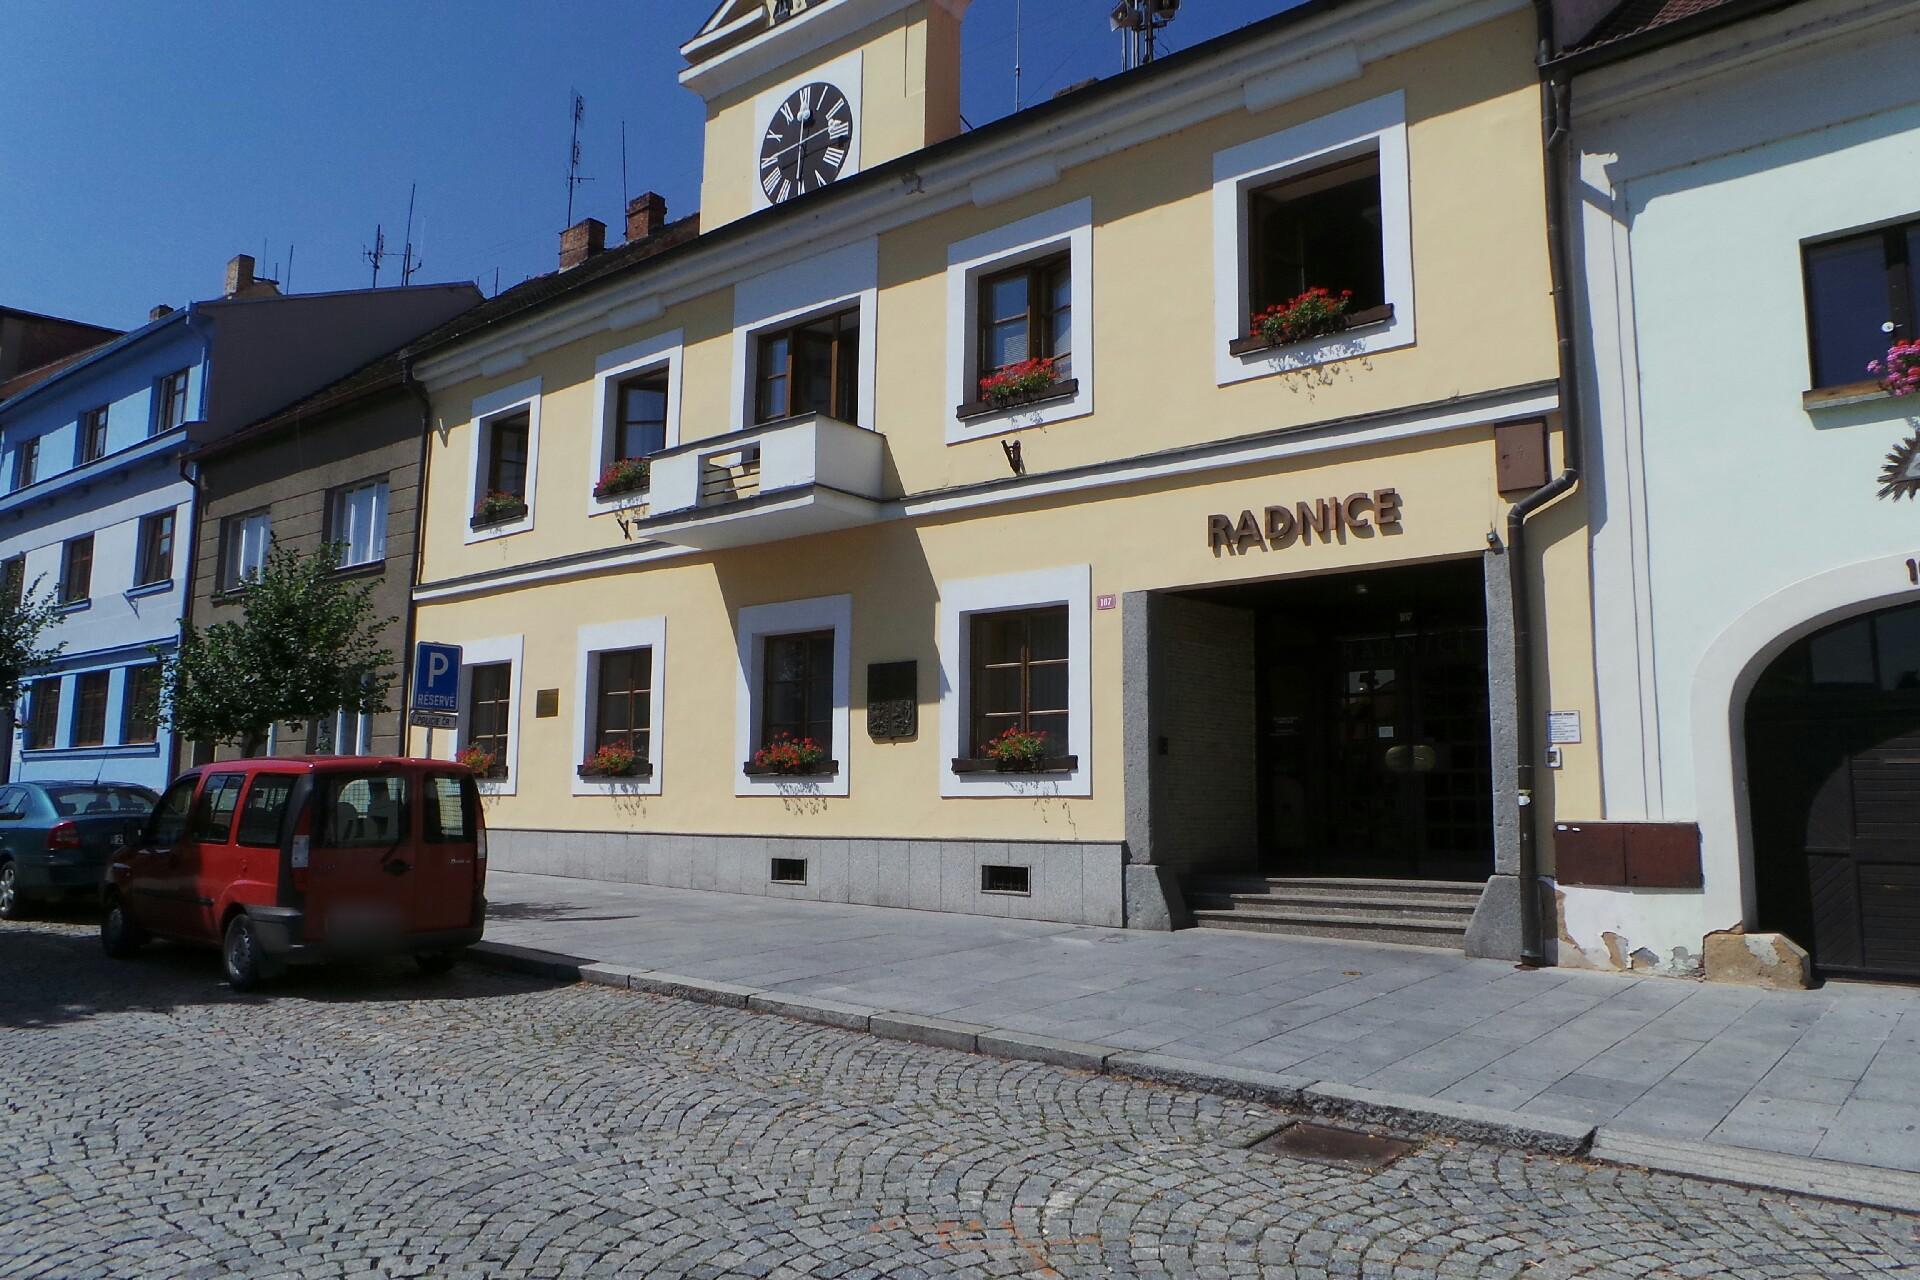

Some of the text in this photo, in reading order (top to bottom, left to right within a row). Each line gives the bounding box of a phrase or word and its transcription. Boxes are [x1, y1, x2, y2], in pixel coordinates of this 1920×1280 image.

[1207, 487, 1397, 553] RADNICE
[1100, 597, 1112, 607] 107
[428, 652, 448, 688] P
